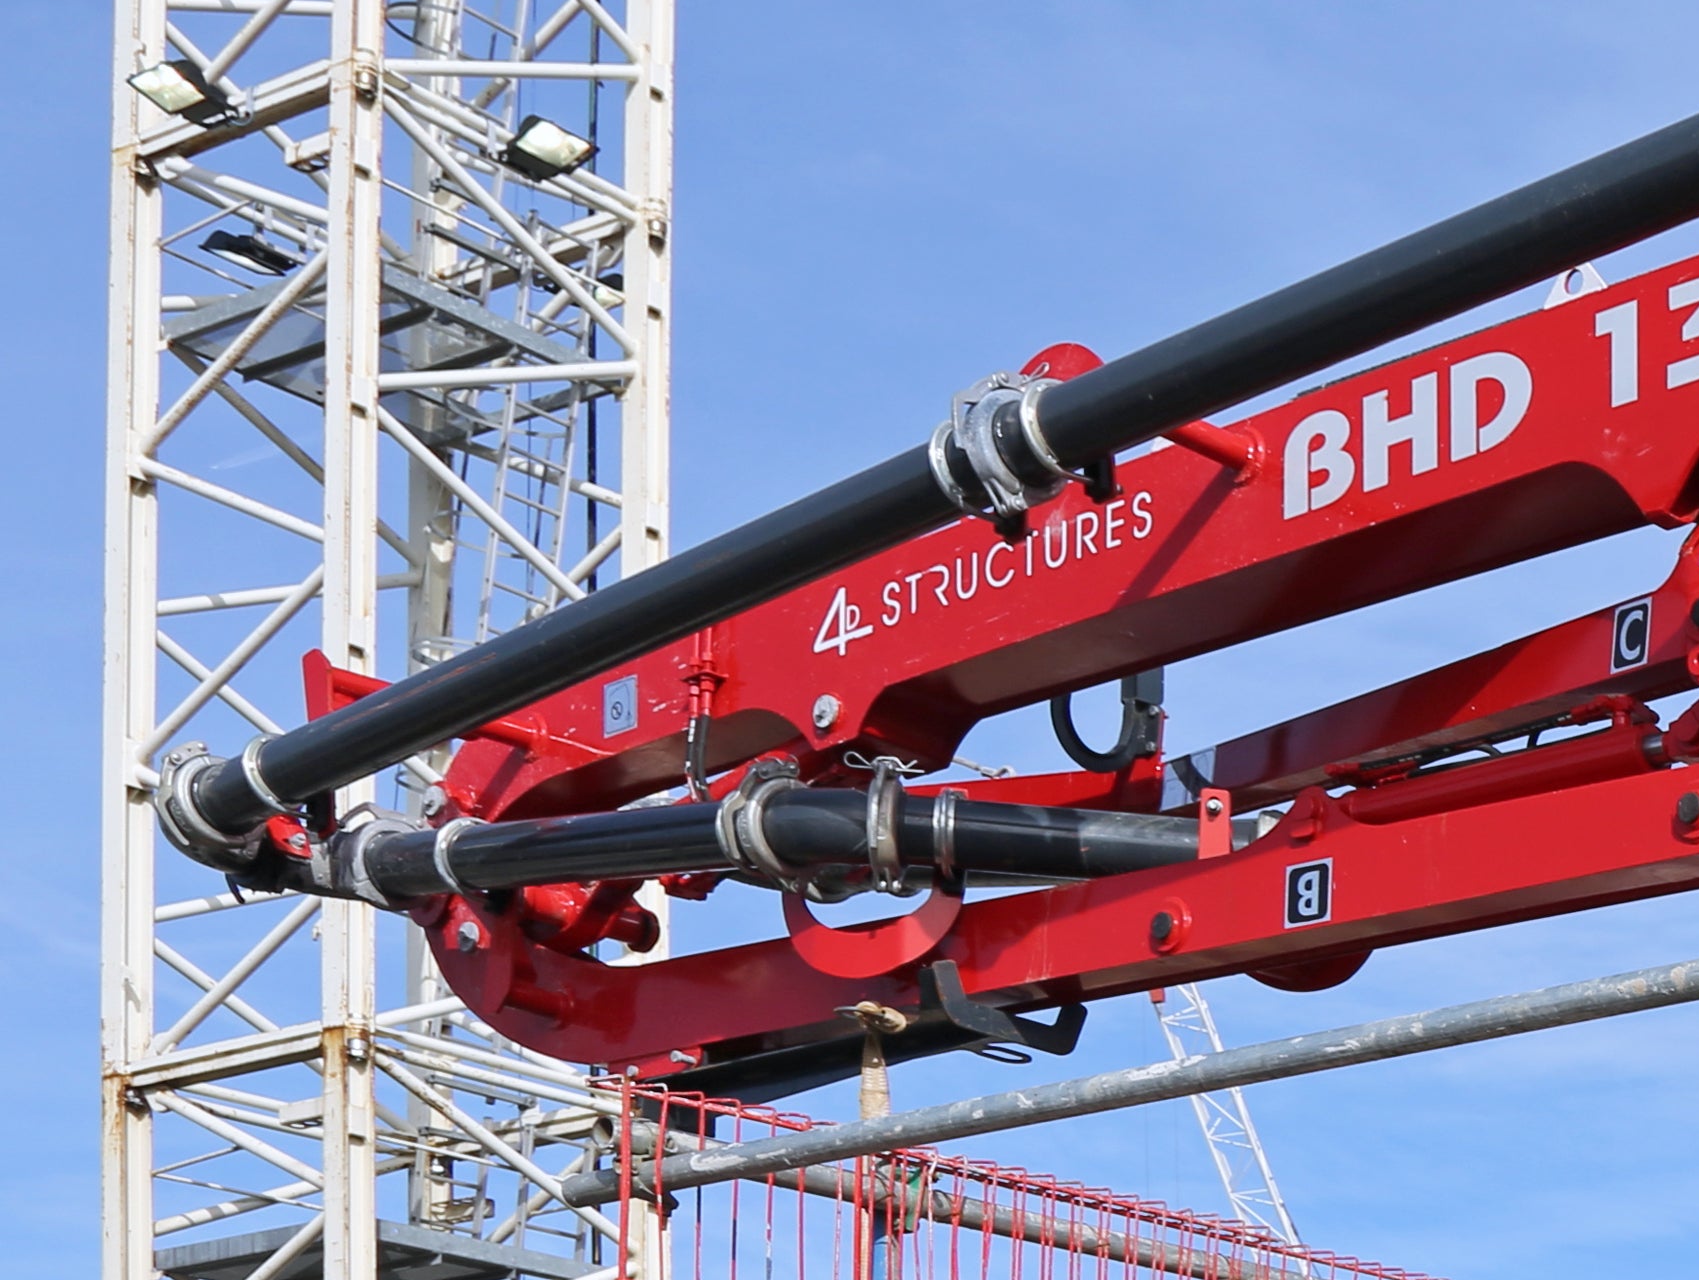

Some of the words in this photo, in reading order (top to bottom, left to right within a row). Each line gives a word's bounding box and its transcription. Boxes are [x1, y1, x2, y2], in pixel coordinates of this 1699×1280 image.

[1282, 350, 1533, 521] BHD
[881, 490, 1153, 628] STRUCTURES
[1618, 609, 1645, 662] C
[1296, 868, 1322, 918] B
